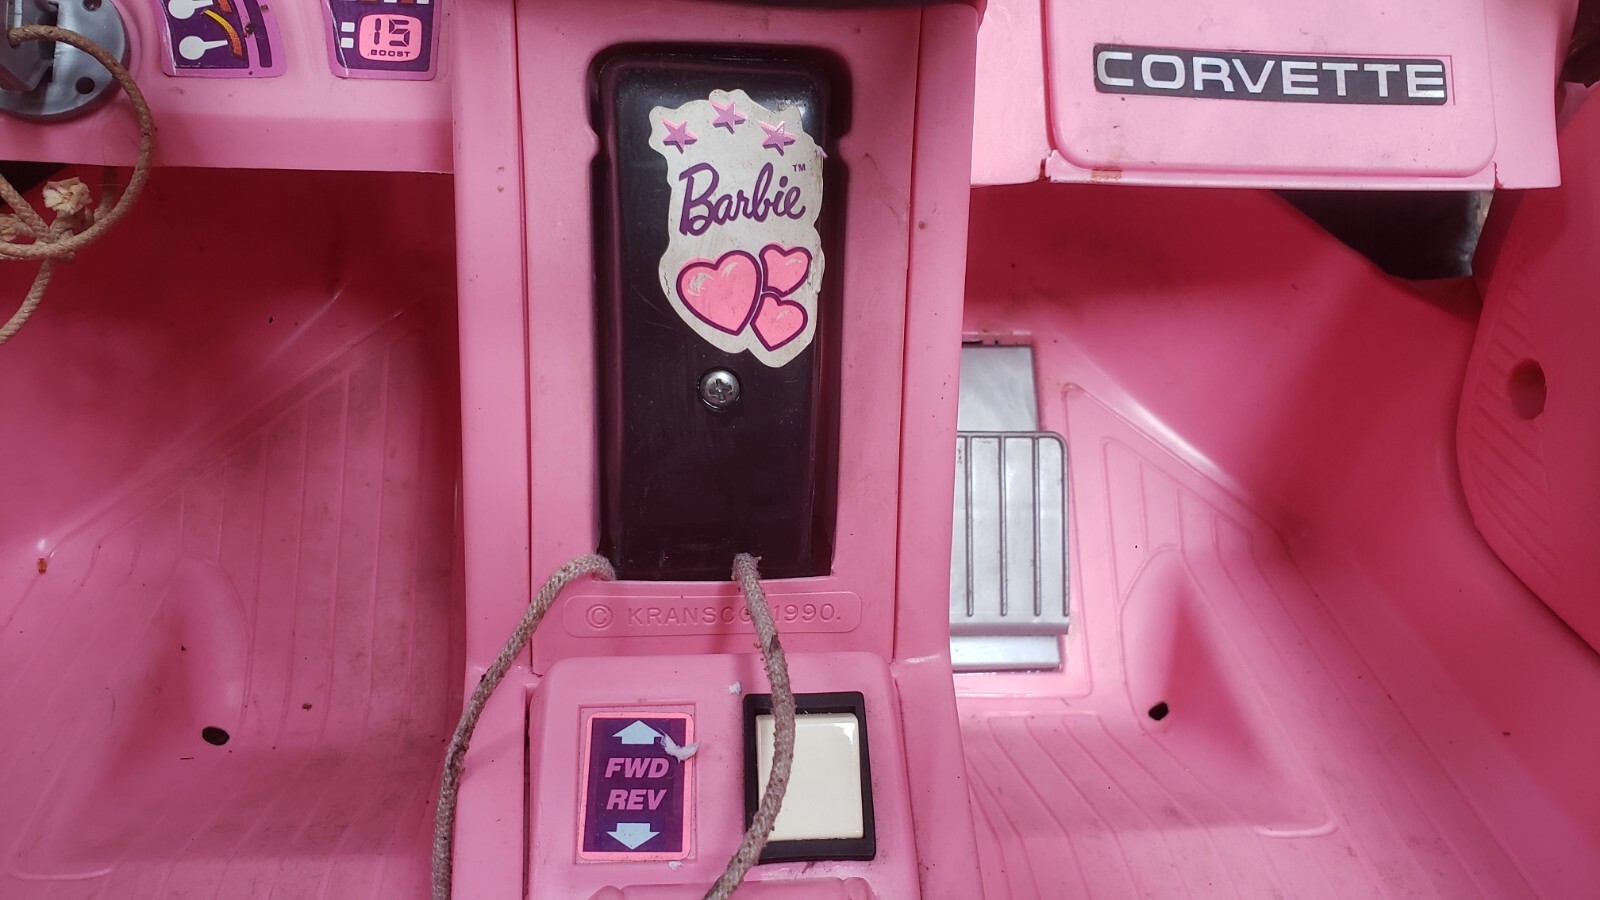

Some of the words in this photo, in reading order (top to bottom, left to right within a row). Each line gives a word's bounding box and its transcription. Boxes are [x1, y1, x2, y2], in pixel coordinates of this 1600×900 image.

[373, 17, 411, 47] 15
[370, 49, 411, 58] BOOST
[1095, 50, 1446, 99] CORVETTE
[678, 162, 806, 236] Barbie
[604, 757, 670, 779] FWD
[606, 789, 667, 811] REV
